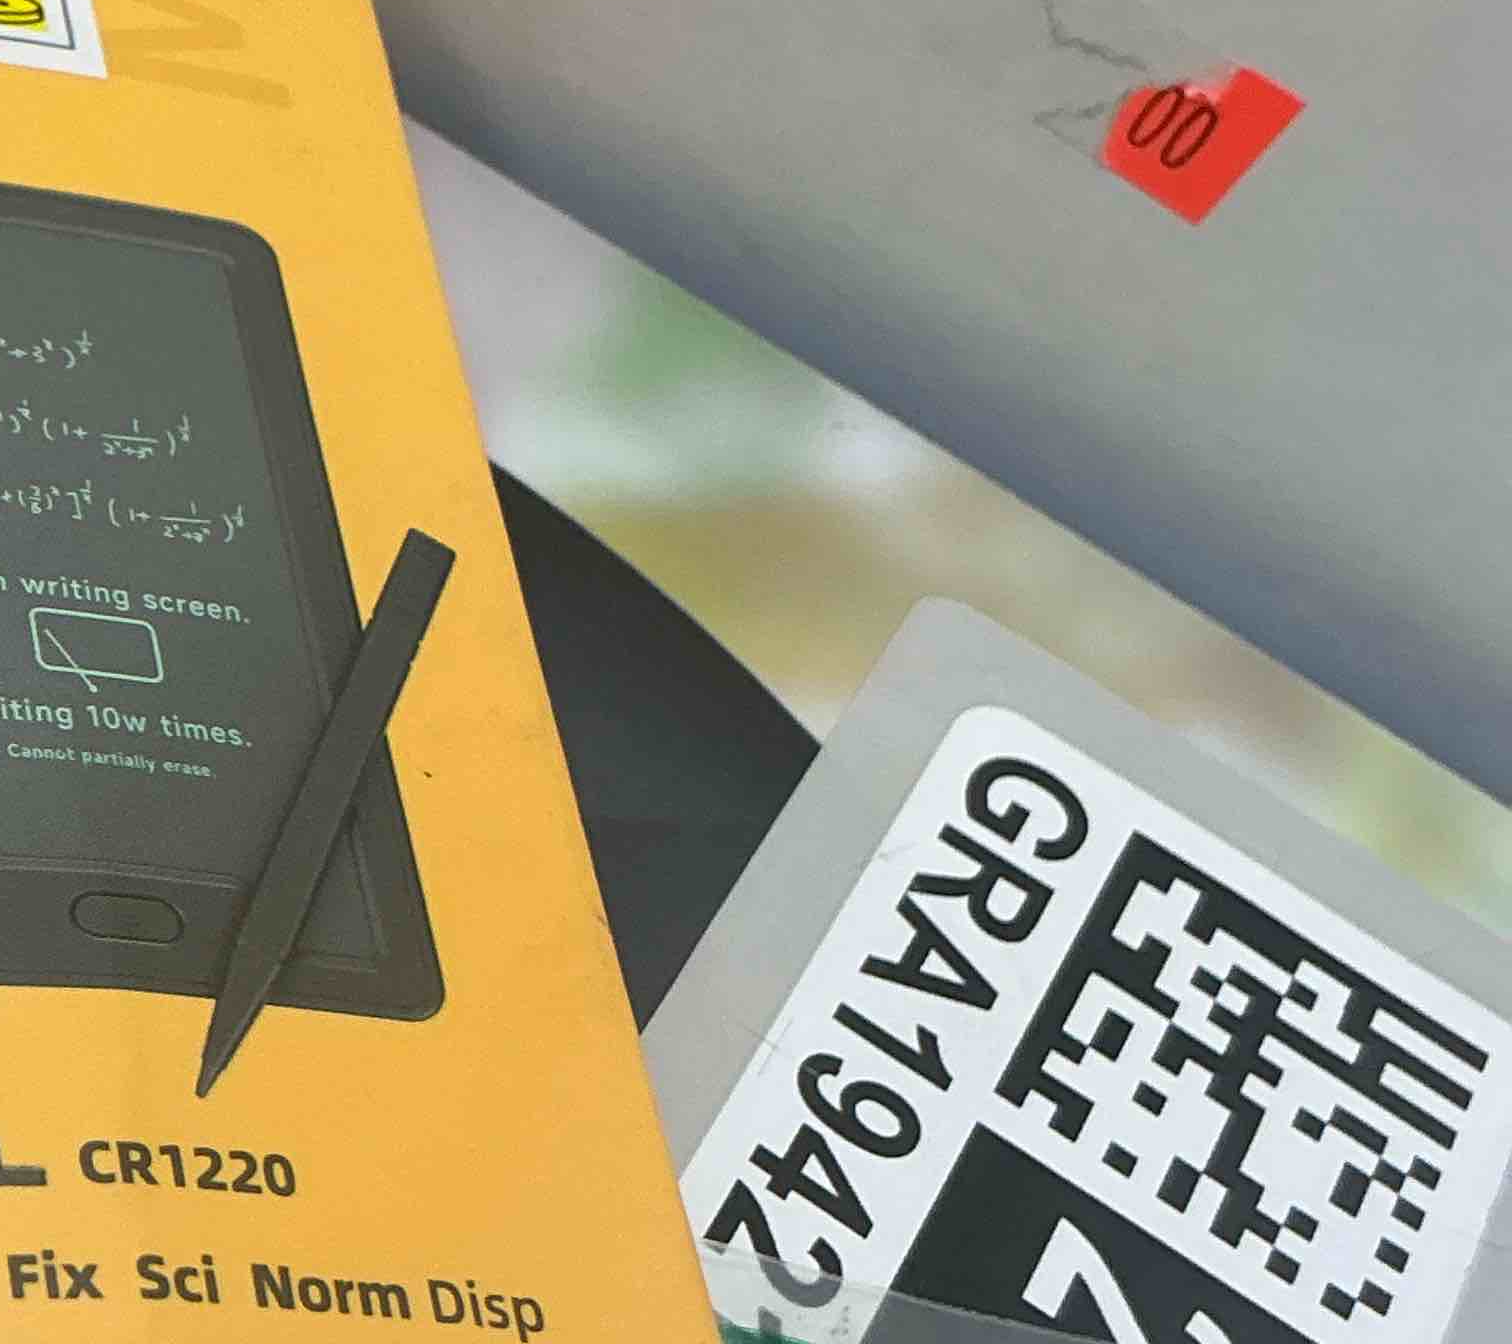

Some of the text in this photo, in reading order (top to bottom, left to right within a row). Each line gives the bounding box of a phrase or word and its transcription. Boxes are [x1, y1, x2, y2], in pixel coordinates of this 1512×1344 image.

[19, 576, 132, 612] writing
[142, 592, 252, 625] screen.
[86, 706, 148, 734] 10w
[160, 714, 253, 748] times.
[6, 742, 218, 780] Cannot partially erase.
[77, 1138, 296, 1198] CR1220
[7, 1248, 105, 1301] Fix
[136, 1252, 221, 1306] Sci
[252, 1262, 412, 1322] Norm
[430, 1278, 547, 1344] Disp
